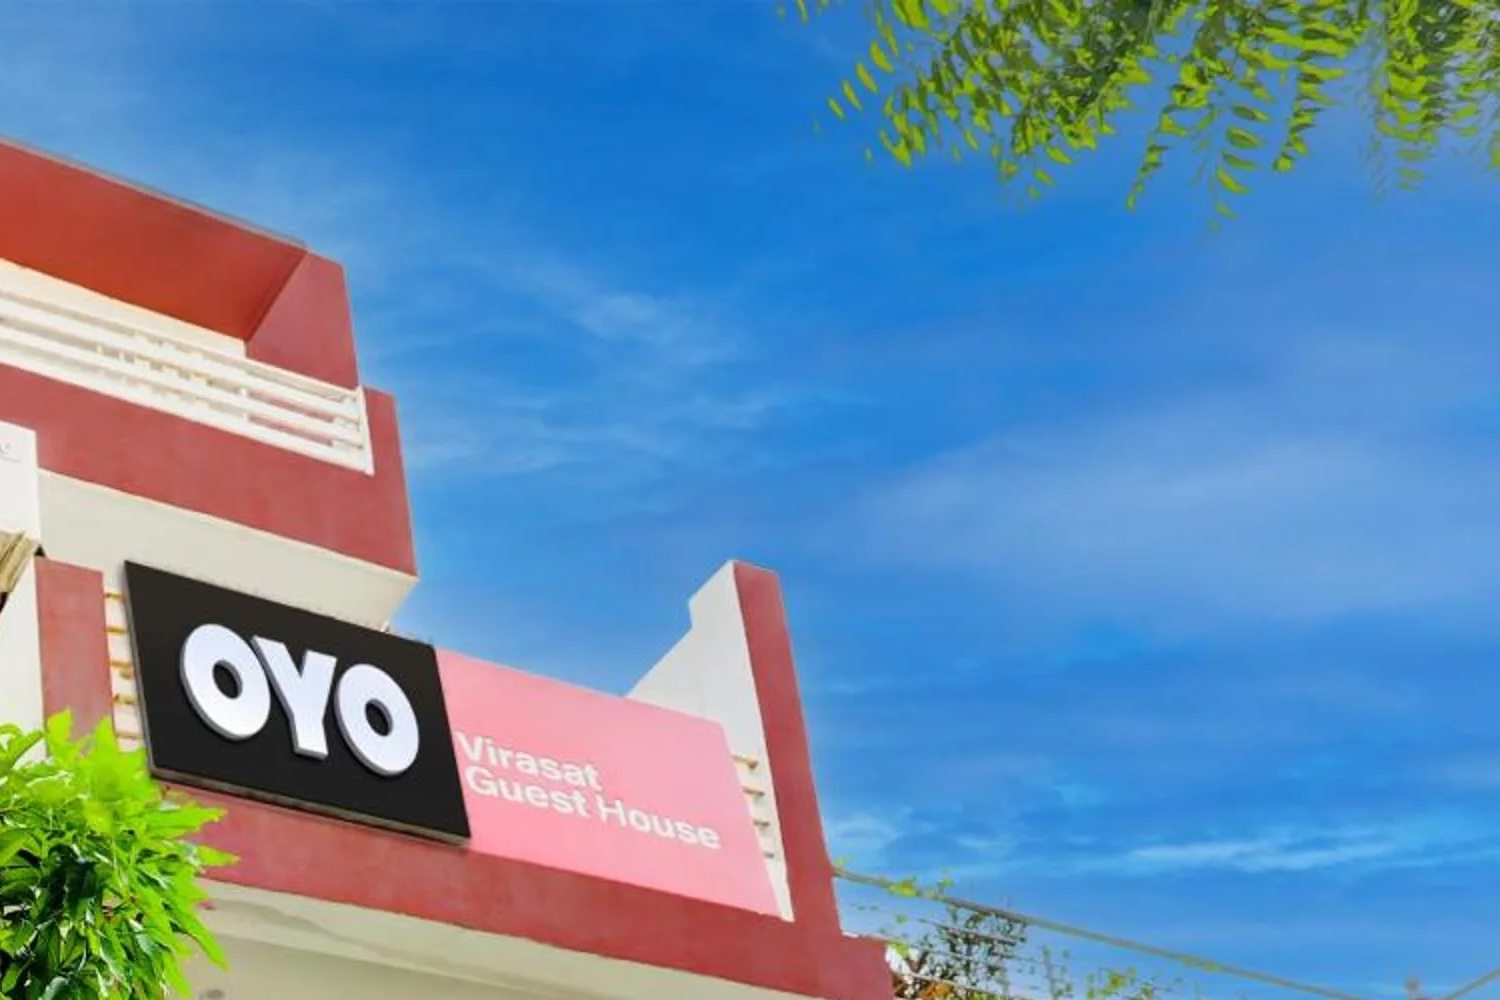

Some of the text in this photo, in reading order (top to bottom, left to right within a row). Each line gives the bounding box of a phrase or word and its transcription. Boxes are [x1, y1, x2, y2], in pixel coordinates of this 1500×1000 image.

[180, 623, 420, 776] OYO
[455, 731, 602, 791] Virasat
[465, 766, 722, 849] Guest House
